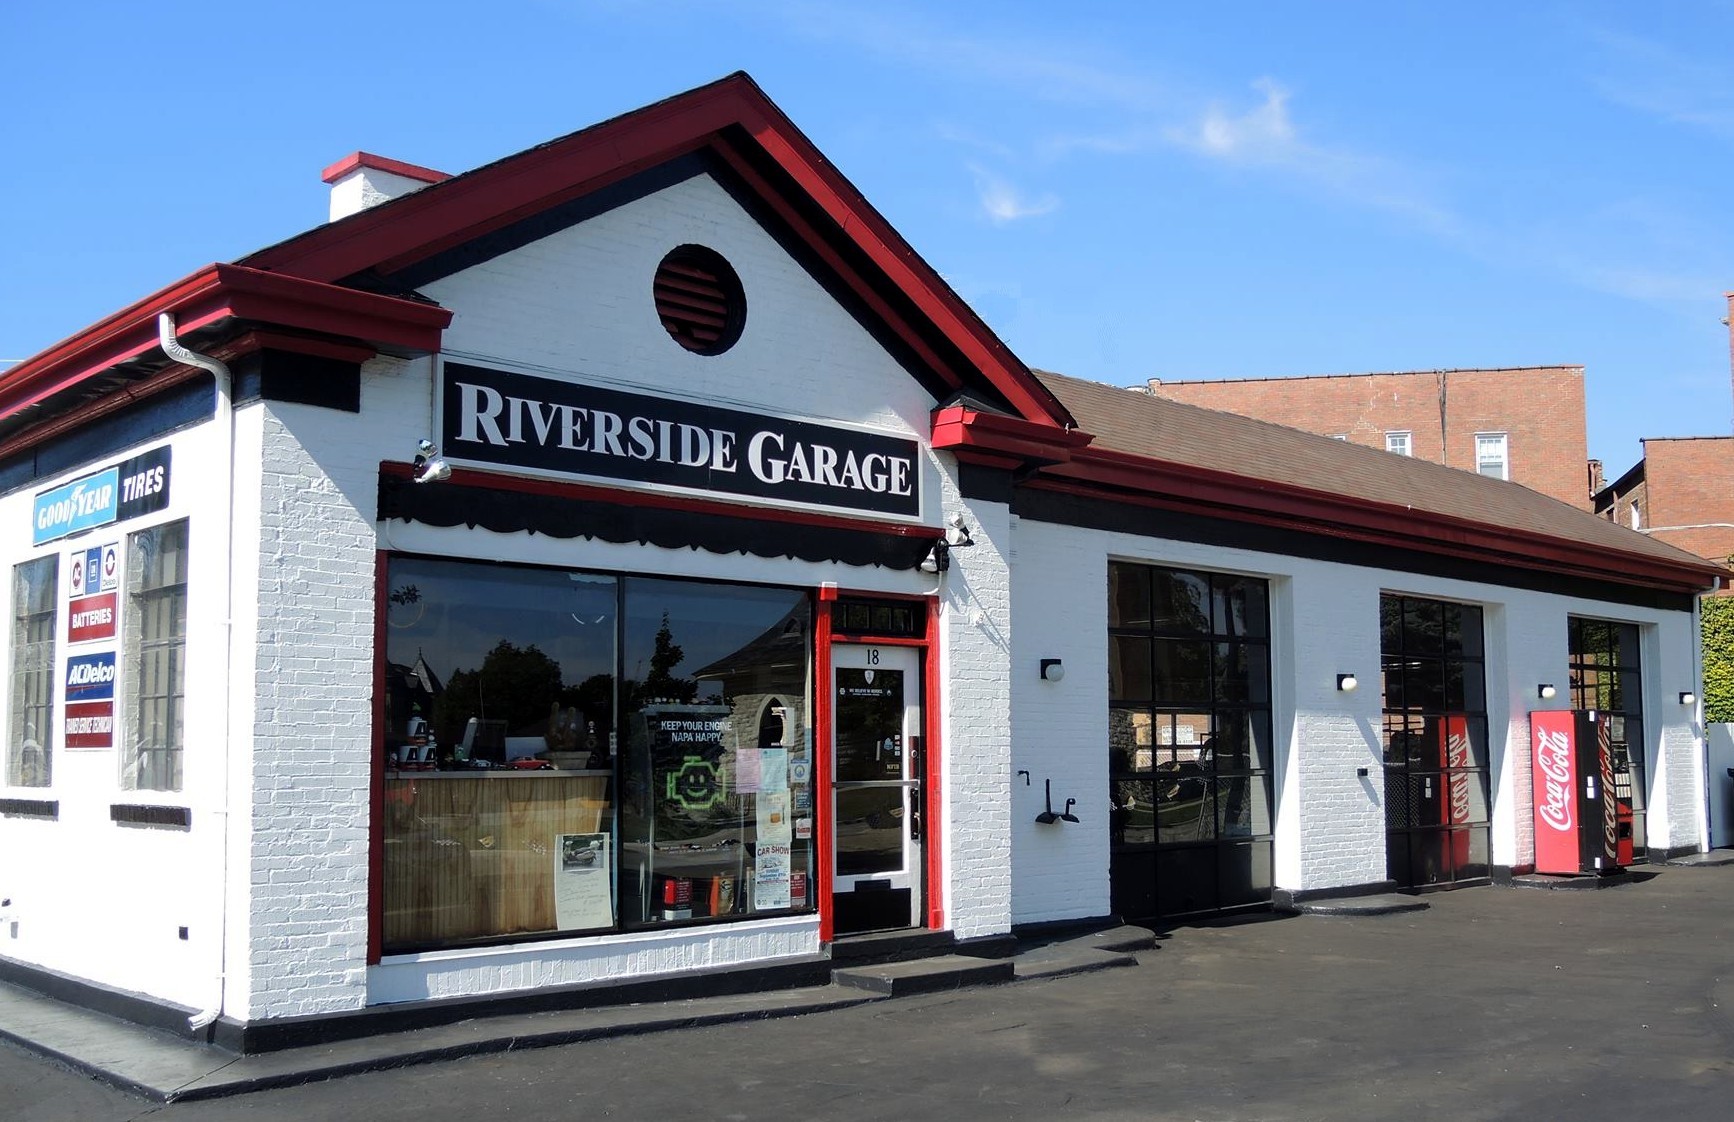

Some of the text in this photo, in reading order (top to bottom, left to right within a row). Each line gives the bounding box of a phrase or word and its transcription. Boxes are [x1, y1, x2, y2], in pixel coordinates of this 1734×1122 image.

[455, 382, 912, 497] RIVERSIDE GARAGE
[123, 466, 164, 503] TIRES
[72, 607, 112, 629] BATTERIES
[867, 649, 880, 665] 18
[67, 661, 115, 685] ACDelco
[661, 720, 682, 731] KEEP
[682, 720, 703, 731] YOUR
[671, 732, 693, 742] NAPA
[1537, 724, 1572, 832] Coca-Cola
[757, 845, 789, 857] CAR SHOW
